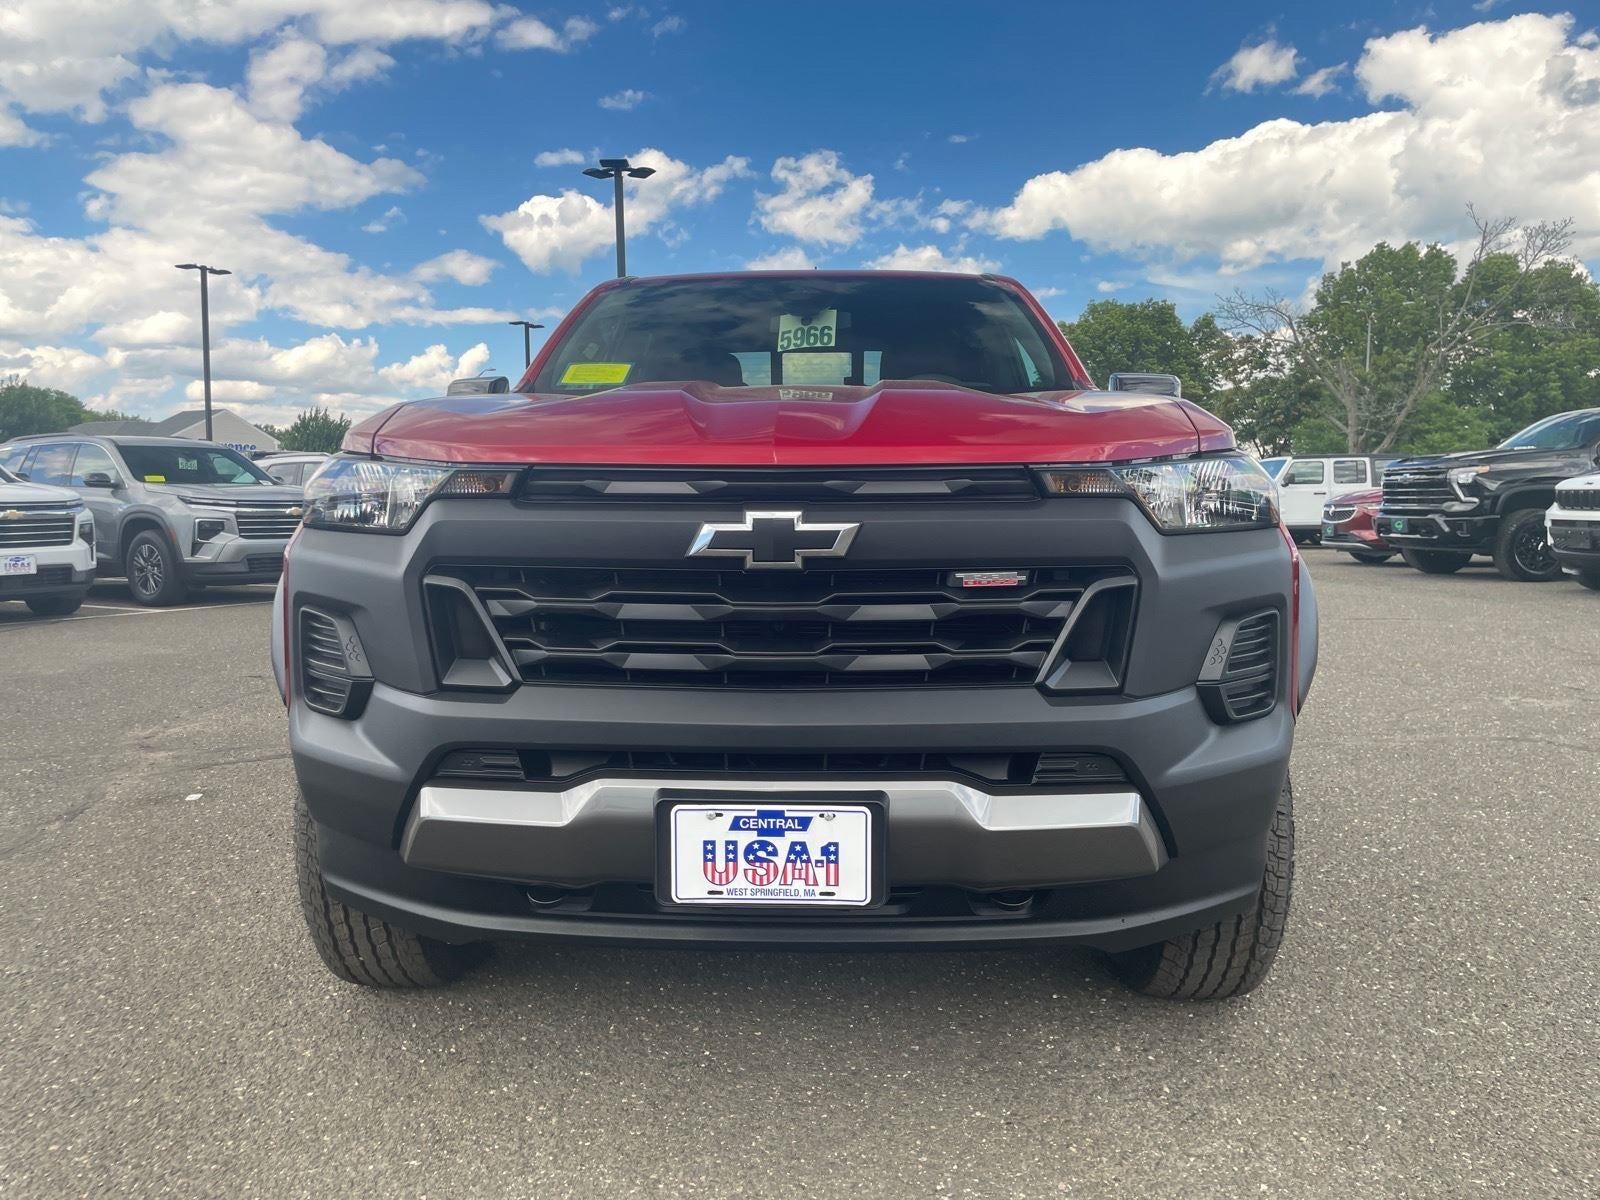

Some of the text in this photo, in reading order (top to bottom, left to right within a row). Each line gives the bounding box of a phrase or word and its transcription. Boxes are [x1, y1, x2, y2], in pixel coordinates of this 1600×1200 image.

[779, 325, 833, 351] 5966
[739, 818, 803, 829] CENTRAL
[702, 839, 840, 886] USA-1
[726, 887, 817, 898] WEST SPRINGFIELD, MA
